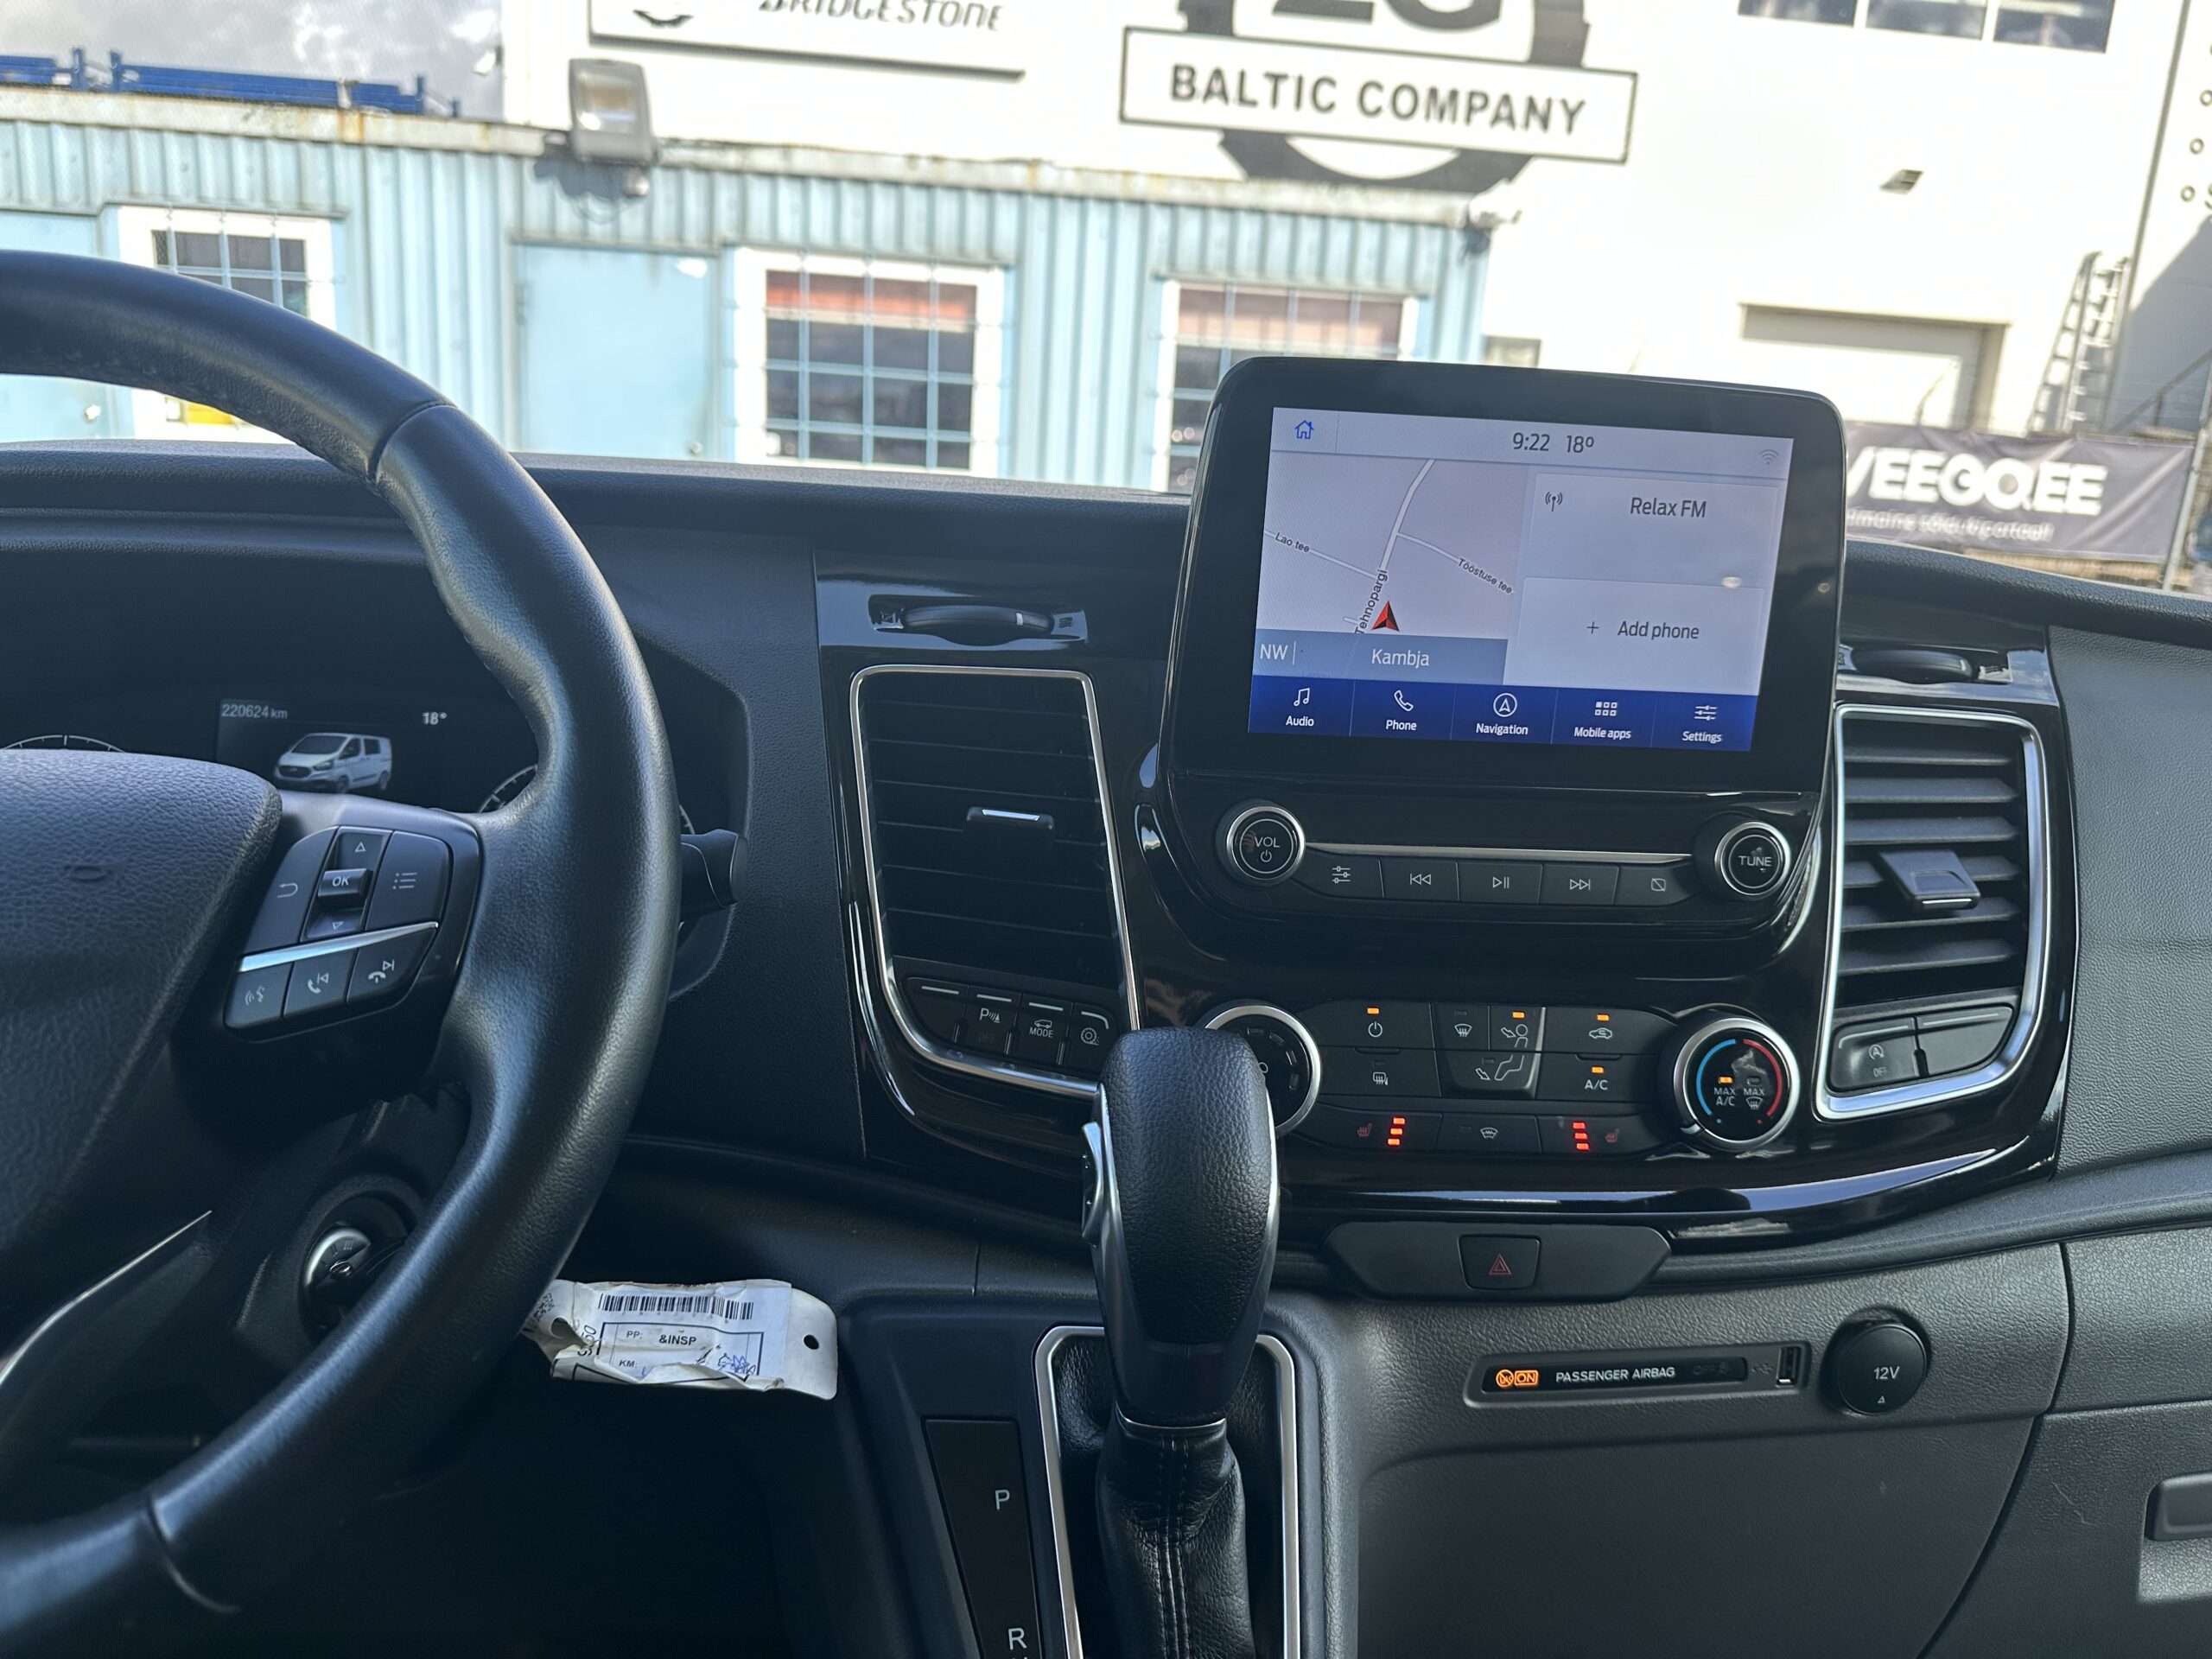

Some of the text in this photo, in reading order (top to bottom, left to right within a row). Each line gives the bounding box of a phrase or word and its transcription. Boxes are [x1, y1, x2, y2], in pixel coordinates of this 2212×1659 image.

[1170, 63, 1586, 135] BALTIC COMPANY
[1512, 432, 1550, 452] 9:22
[1630, 497, 1707, 518] Relax FM
[1274, 531, 1310, 553] Lao tee
[1497, 578, 1512, 594] tee
[1355, 569, 1388, 634] Tehnopargi
[1617, 620, 1700, 640] Add phone
[1259, 644, 1288, 660] NW
[1371, 649, 1430, 669] Kambja
[221, 703, 288, 719] 220624 km
[422, 711, 447, 725] 18°
[1285, 715, 1315, 727] Audio
[1385, 720, 1417, 731] Phone
[1476, 722, 1529, 736] Navigation
[1573, 727, 1631, 741] Mobile apps
[1681, 731, 1722, 744] Settings
[1254, 836, 1281, 849] VOL
[1738, 855, 1772, 867] TUNE
[332, 876, 350, 887] OK
[1028, 1027, 1054, 1039] MODE
[1584, 1078, 1609, 1090] A/C
[1713, 1087, 1736, 1096] MAX
[1743, 1088, 1765, 1096] MAX
[1715, 1096, 1735, 1106] A/C
[626, 1330, 643, 1339] PP:
[658, 1333, 697, 1346] &INSP
[619, 1358, 638, 1369] KM:
[1516, 1373, 1535, 1382] ON
[1555, 1369, 1628, 1382] PASSENGER
[1631, 1366, 1676, 1380] AIRBAG
[1873, 1366, 1900, 1380] 12V
[995, 1490, 1010, 1510] P
[1007, 1628, 1027, 1650] R
